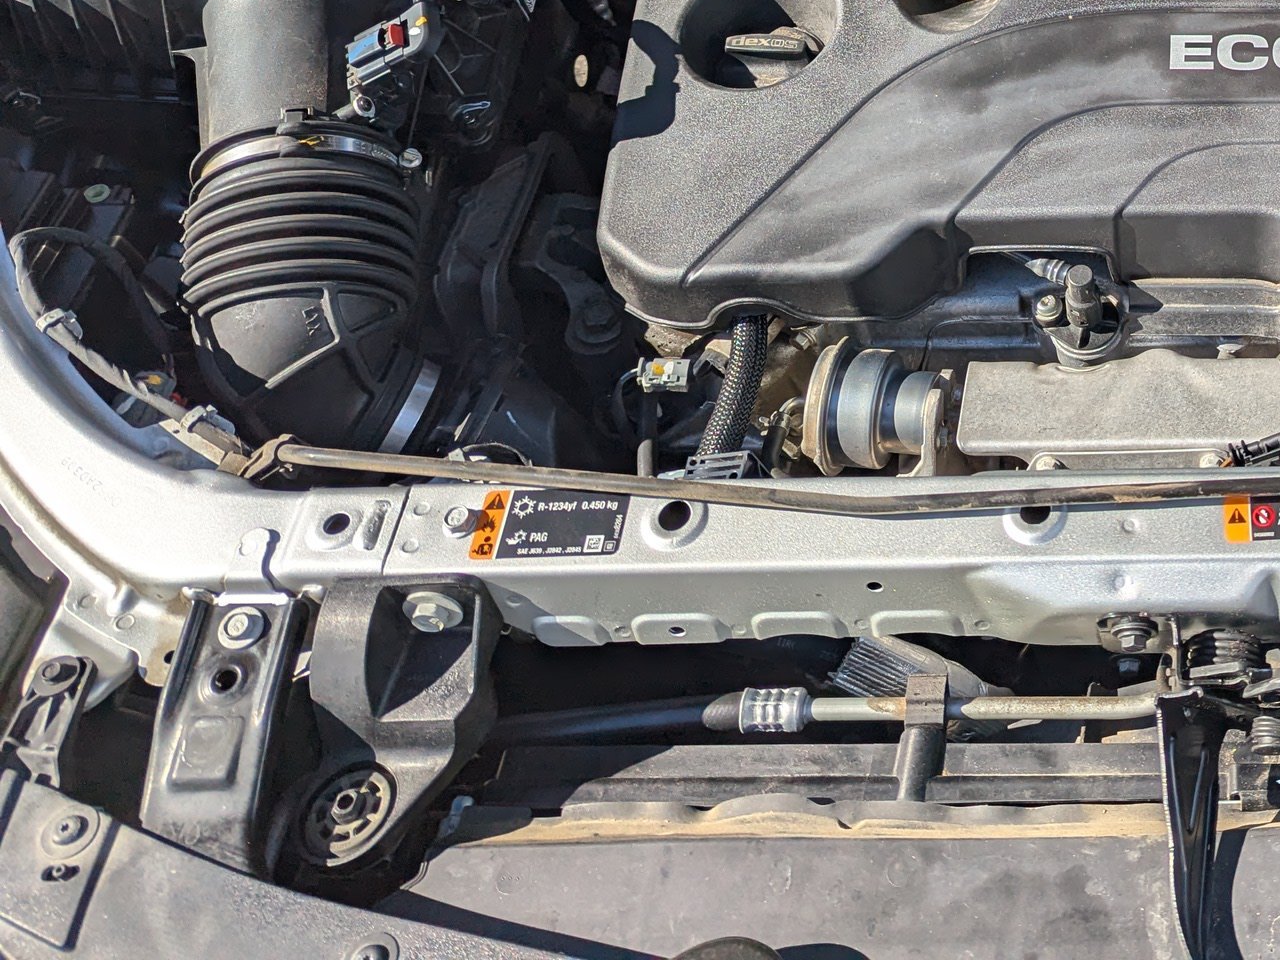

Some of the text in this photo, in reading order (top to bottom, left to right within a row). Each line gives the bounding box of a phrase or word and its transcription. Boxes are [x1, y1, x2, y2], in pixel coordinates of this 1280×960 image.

[732, 36, 798, 48] dexos
[538, 500, 618, 512] R-1234yf 0.450 kg
[530, 532, 548, 542] PAG
